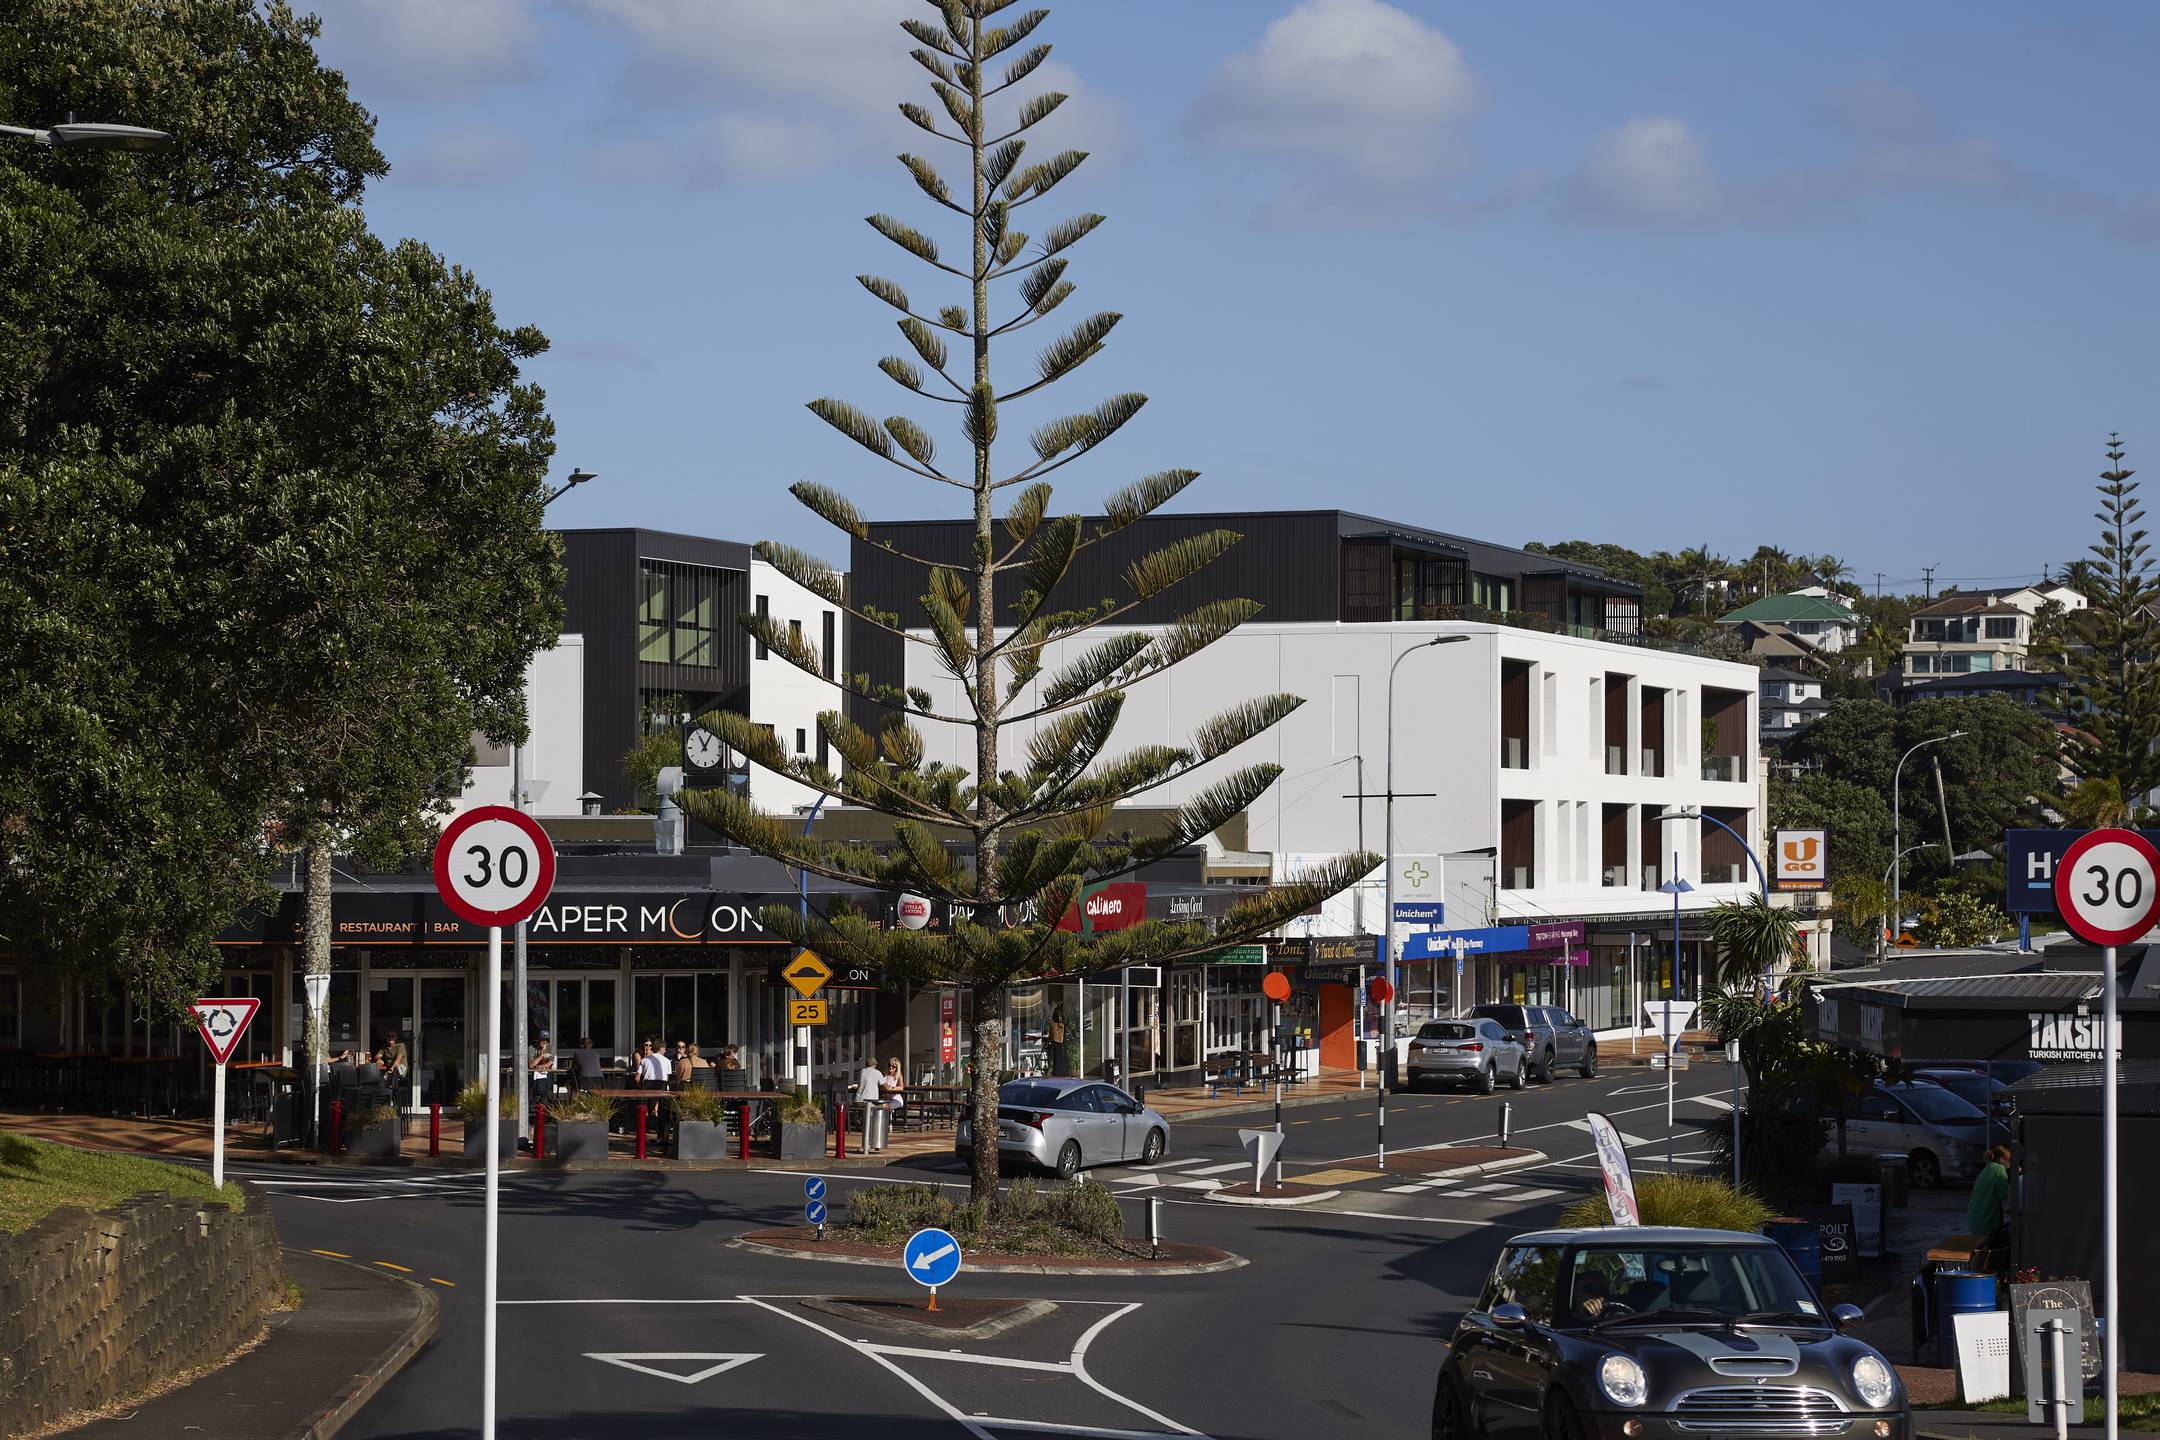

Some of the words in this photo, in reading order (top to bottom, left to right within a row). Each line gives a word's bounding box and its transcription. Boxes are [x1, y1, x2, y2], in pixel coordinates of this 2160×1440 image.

[463, 845, 528, 888] 30
[1784, 863, 1817, 872] GO
[2083, 865, 2142, 908] 30
[949, 902, 975, 926] PAP
[1396, 908, 1434, 918] Unichem
[524, 906, 628, 933] APER
[339, 922, 416, 933] RESTAURANT
[434, 922, 459, 933] BAR
[1279, 943, 1306, 955] Tonic
[1304, 967, 1342, 980] Uniche
[797, 1005, 818, 1018] 25
[2029, 1050, 2062, 1059] TURKISH
[2063, 1051, 2096, 1060] KITCHEN
[2042, 1300, 2063, 1309] The
